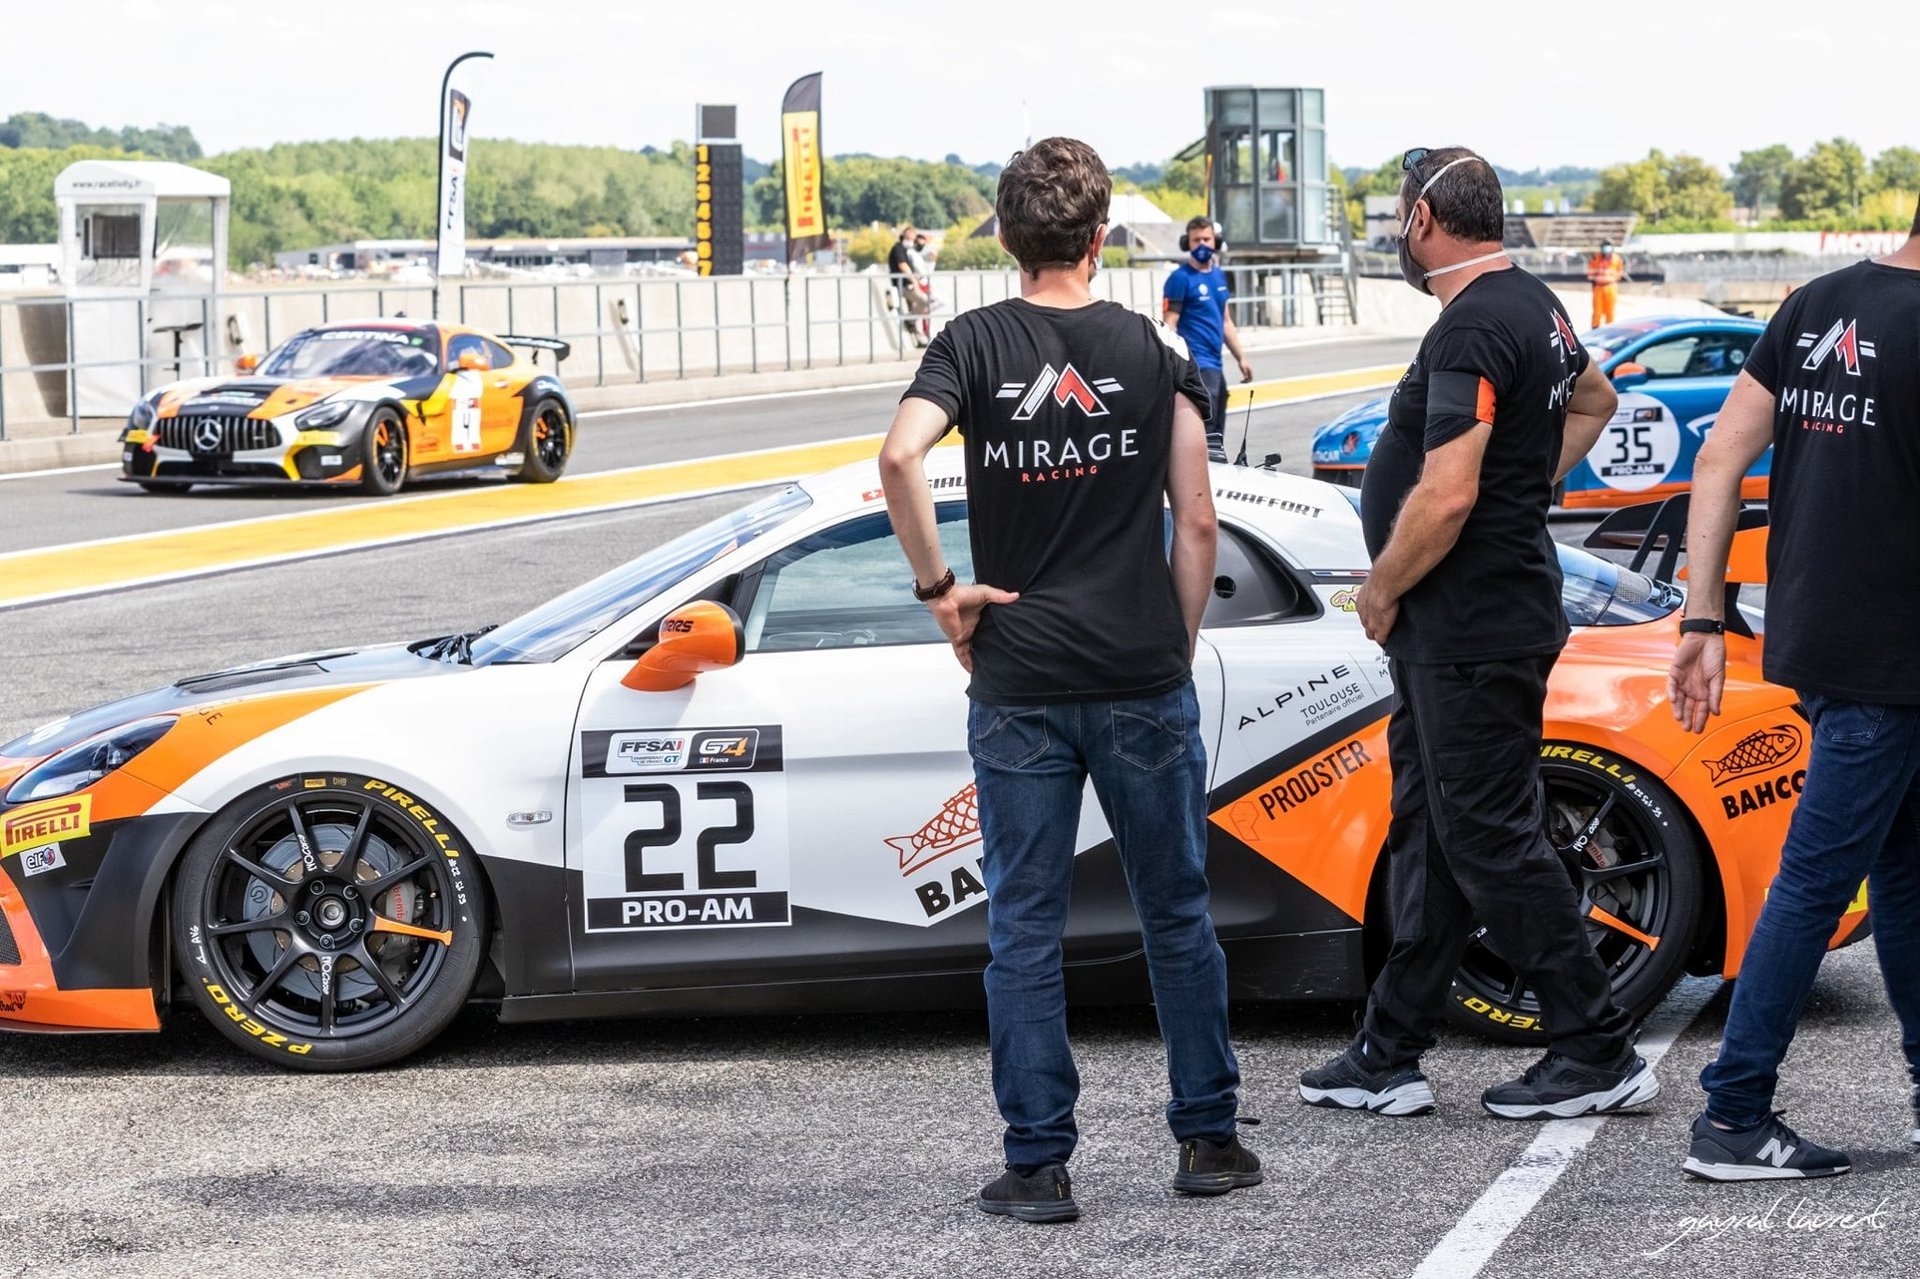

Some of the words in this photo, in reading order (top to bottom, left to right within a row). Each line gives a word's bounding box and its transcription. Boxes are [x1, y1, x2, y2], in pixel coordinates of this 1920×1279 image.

[696, 145, 709, 162] 1
[697, 164, 711, 182] 2
[697, 183, 711, 200] 3
[697, 203, 711, 220] 4
[698, 260, 712, 277] 7
[1780, 387, 1876, 427] MIRAGE
[984, 429, 1139, 469] MIRAGE
[1610, 427, 1652, 464] 35
[1022, 465, 1099, 482] RACING
[1215, 488, 1325, 518] TRAFFORT
[1238, 664, 1350, 731] ALPINE
[1300, 682, 1361, 719] TOULOUSE
[1305, 704, 1341, 727] Partenaire
[621, 741, 676, 753] FFSA
[664, 755, 679, 763] GT
[699, 736, 749, 757] GT4
[1540, 744, 1636, 783] IRELLI
[1258, 740, 1372, 821] PRODSTER
[5, 803, 81, 847] PIRELLI
[364, 780, 460, 858] PIRELLI
[624, 781, 757, 892] 22
[622, 896, 753, 925] PRO-AM
